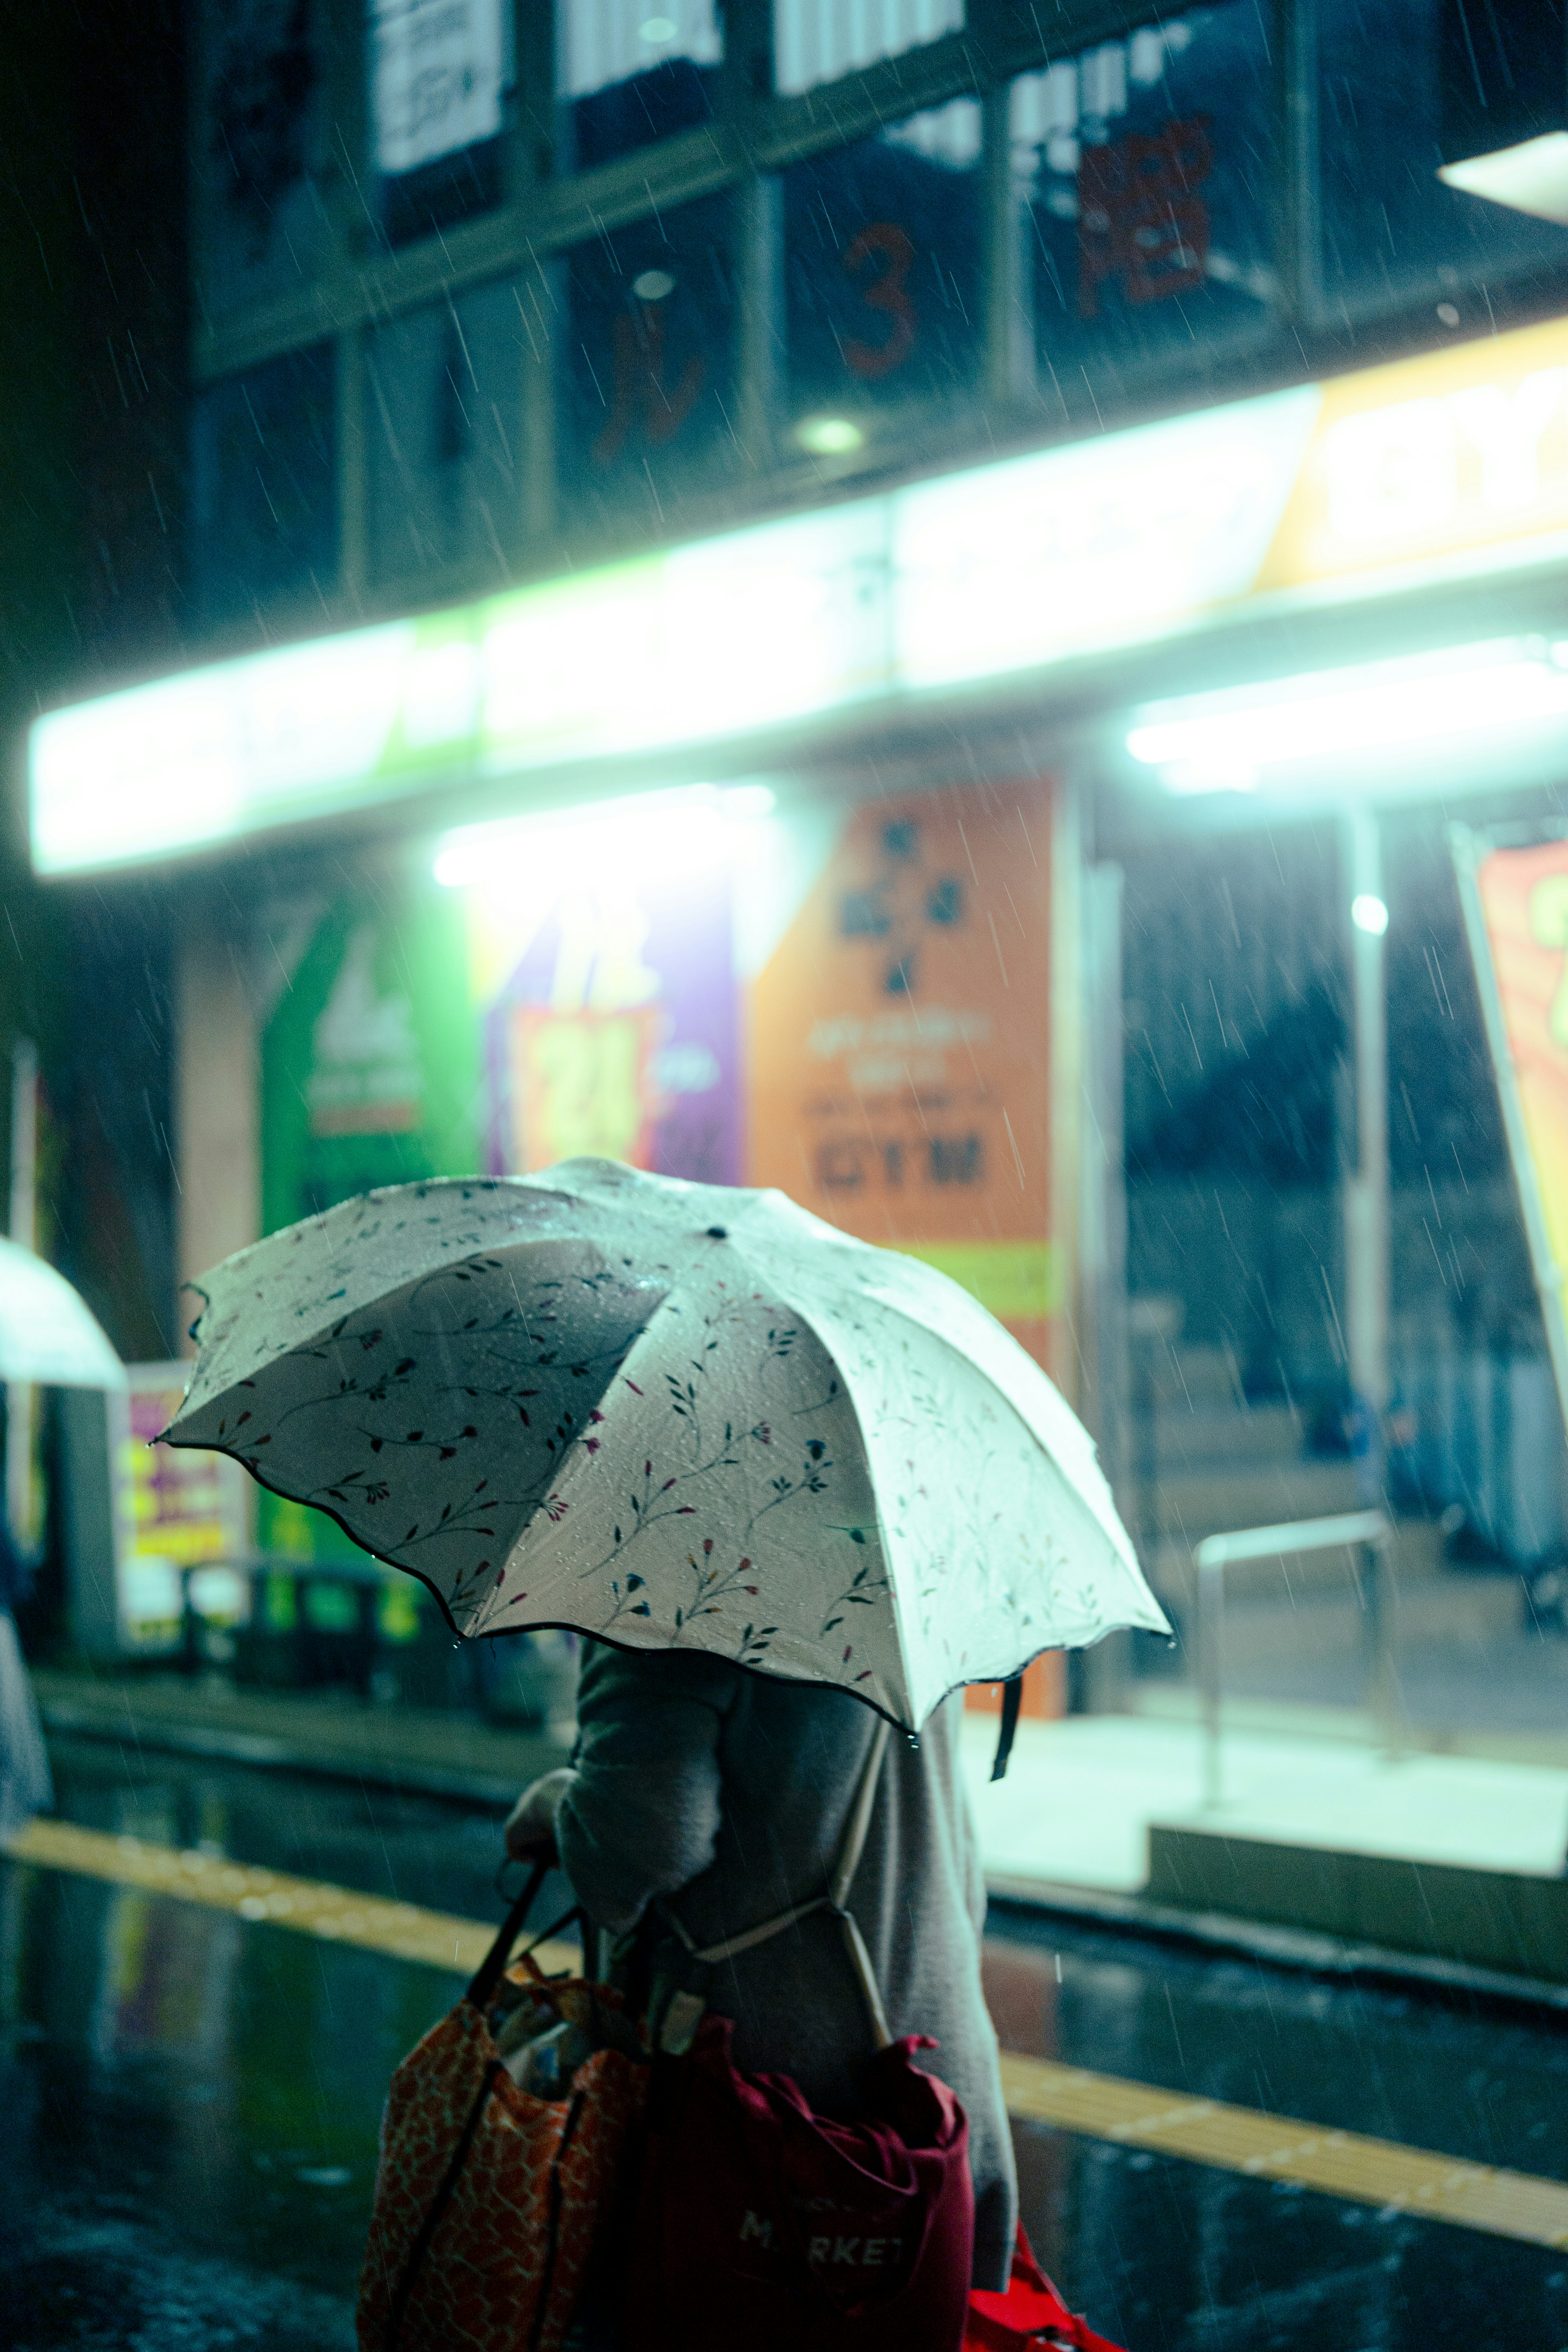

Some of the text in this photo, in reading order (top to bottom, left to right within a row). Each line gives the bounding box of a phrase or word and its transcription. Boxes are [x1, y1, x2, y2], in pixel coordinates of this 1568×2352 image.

[844, 224, 918, 379] 3
[1327, 366, 1568, 541] GY
[739, 2208, 903, 2265] MRKET
